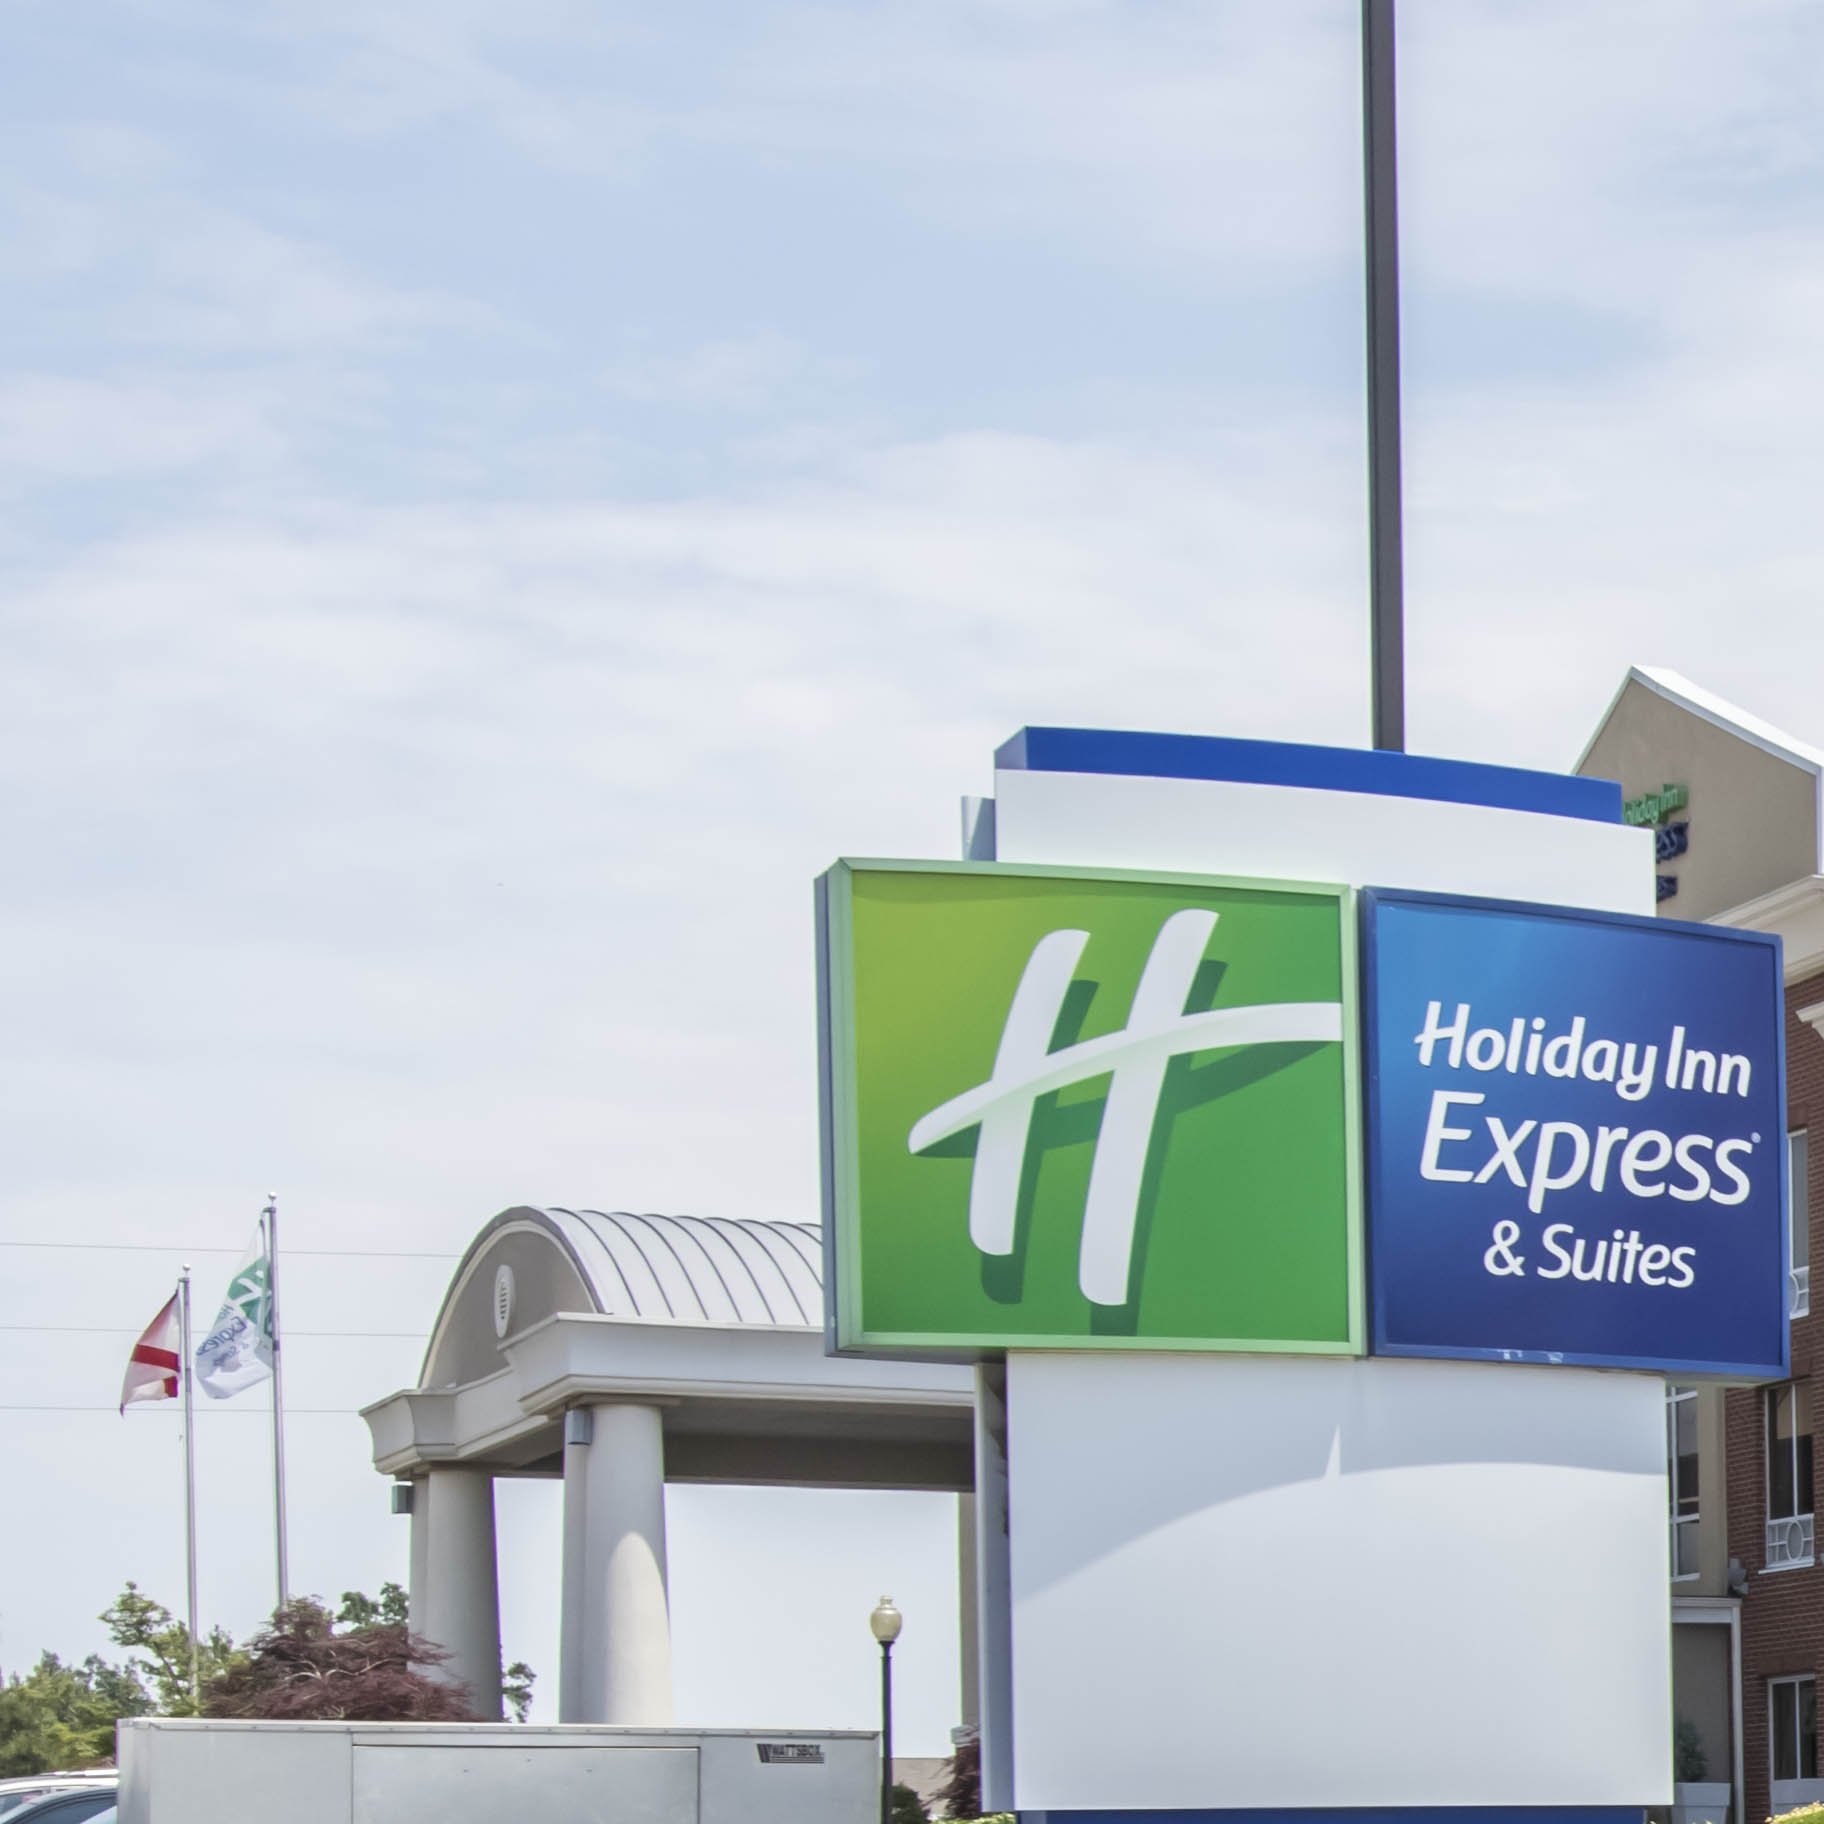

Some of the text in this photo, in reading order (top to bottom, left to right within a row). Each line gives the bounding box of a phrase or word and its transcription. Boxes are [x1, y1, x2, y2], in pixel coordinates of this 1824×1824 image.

[1623, 797, 1660, 825] oliday
[1414, 1000, 1752, 1101] Holiday Inn
[1420, 1090, 1753, 1214] Express
[1483, 1219, 1697, 1288] & Suites
